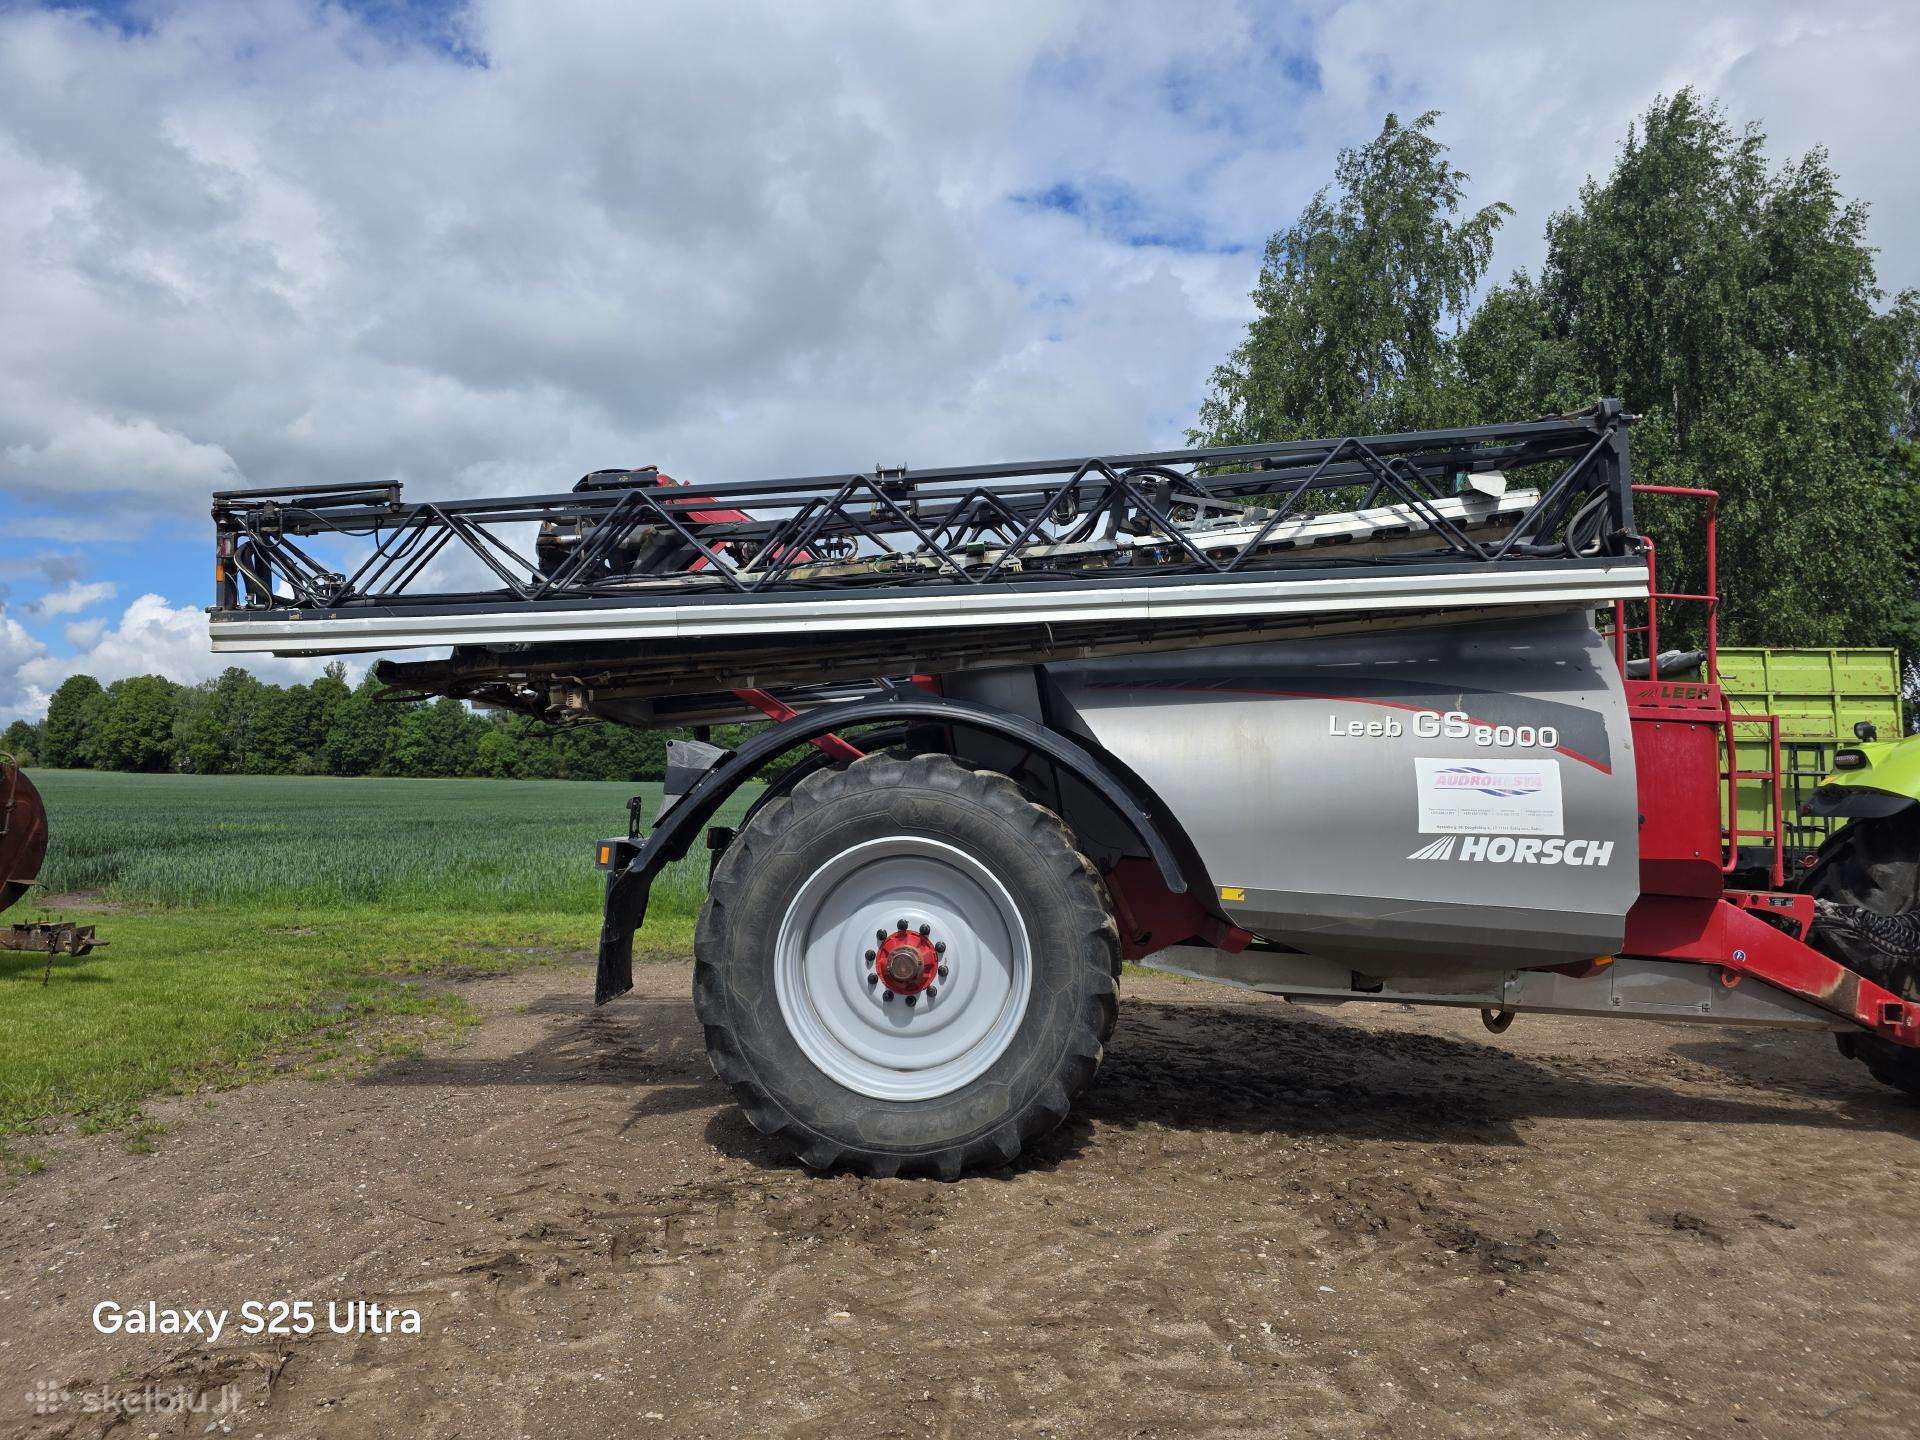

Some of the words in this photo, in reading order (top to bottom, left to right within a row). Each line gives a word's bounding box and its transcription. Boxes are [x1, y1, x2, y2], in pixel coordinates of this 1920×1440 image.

[1329, 715, 1403, 738] Leeb
[1412, 711, 1471, 738] GS
[1474, 726, 1559, 749] 8000
[1459, 837, 1615, 866] HORSCH
